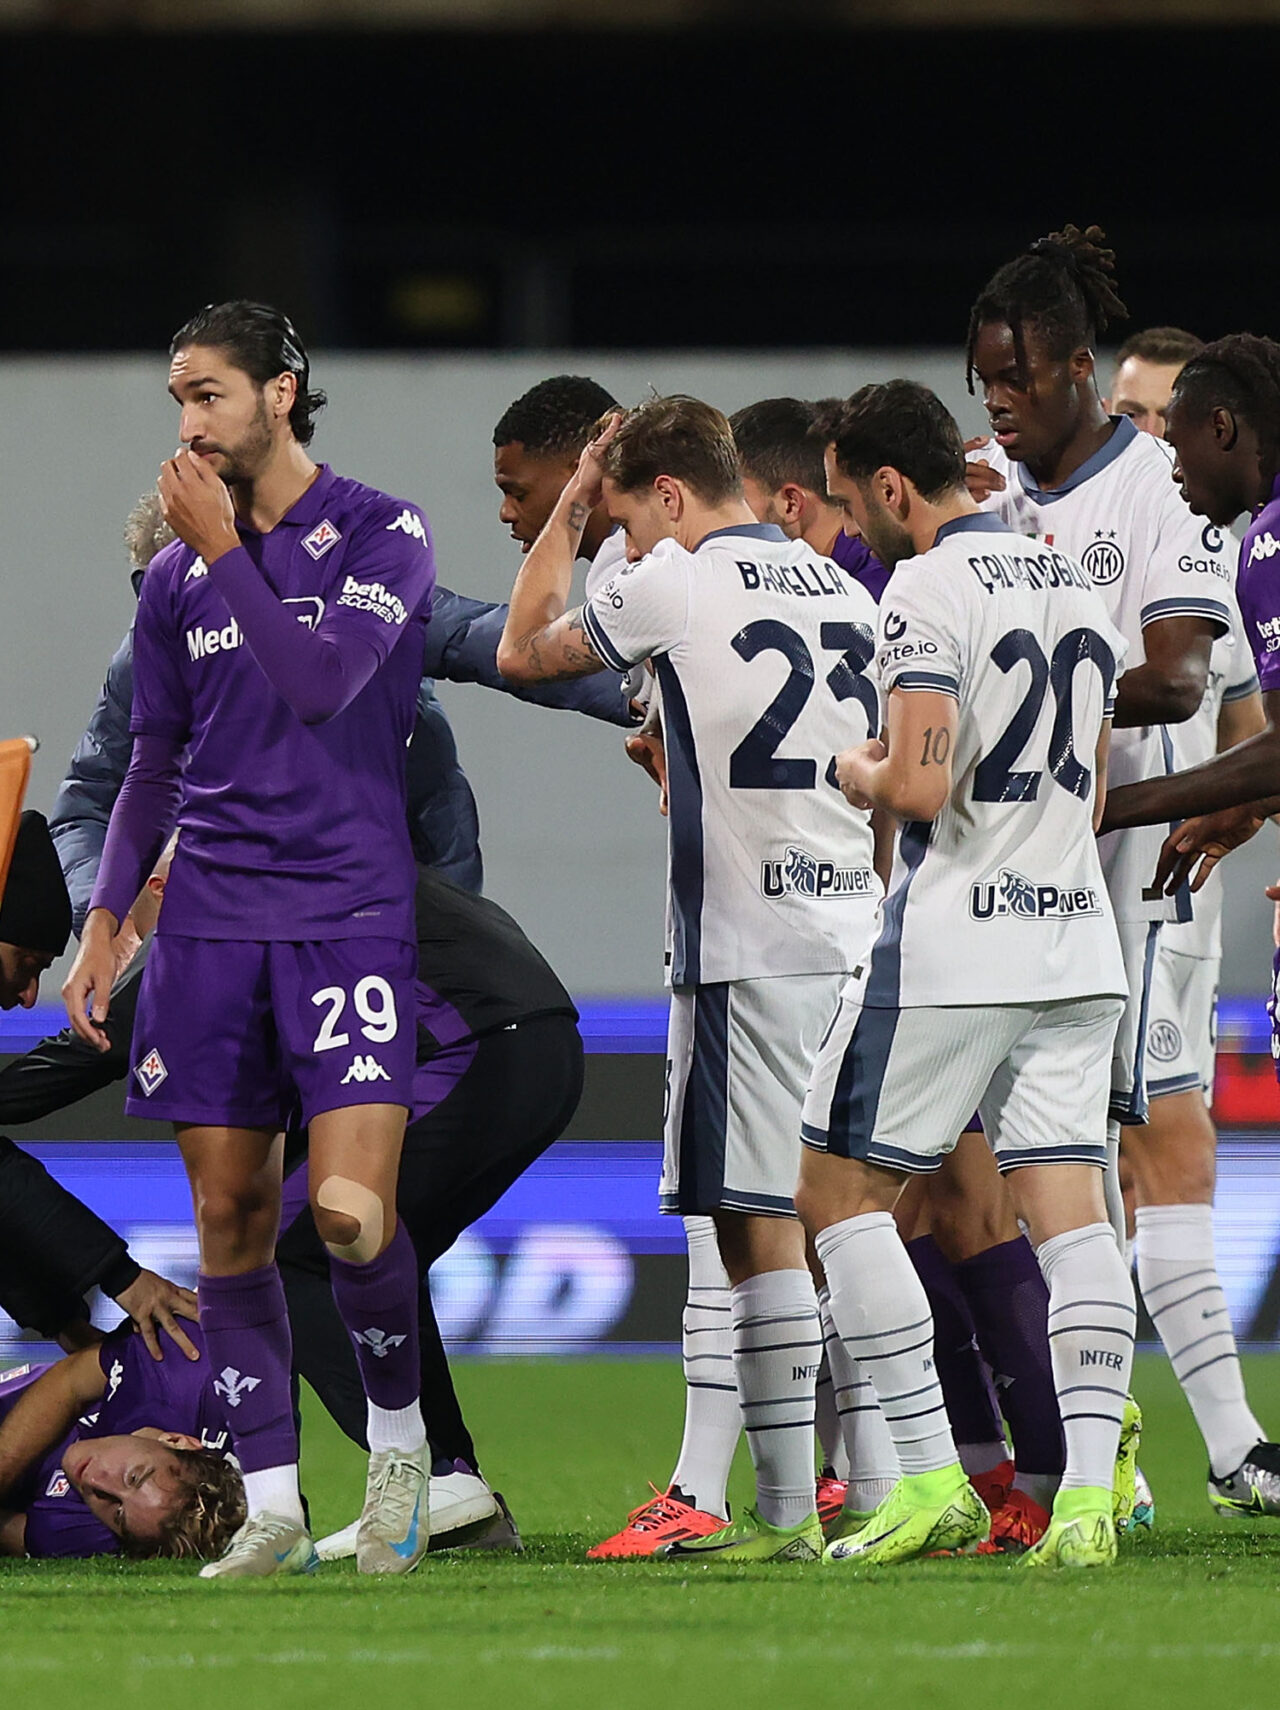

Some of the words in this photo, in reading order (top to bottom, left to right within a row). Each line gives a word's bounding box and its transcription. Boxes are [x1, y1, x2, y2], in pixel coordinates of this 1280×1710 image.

[342, 576, 408, 625] betway
[735, 561, 849, 597] BARELLA
[336, 594, 395, 624] SCORES
[187, 616, 244, 662] Med
[730, 619, 878, 790] 23
[972, 627, 1116, 803] 20
[920, 726, 950, 767] 10
[311, 974, 398, 1053] 29
[1080, 1349, 1124, 1371] INTER
